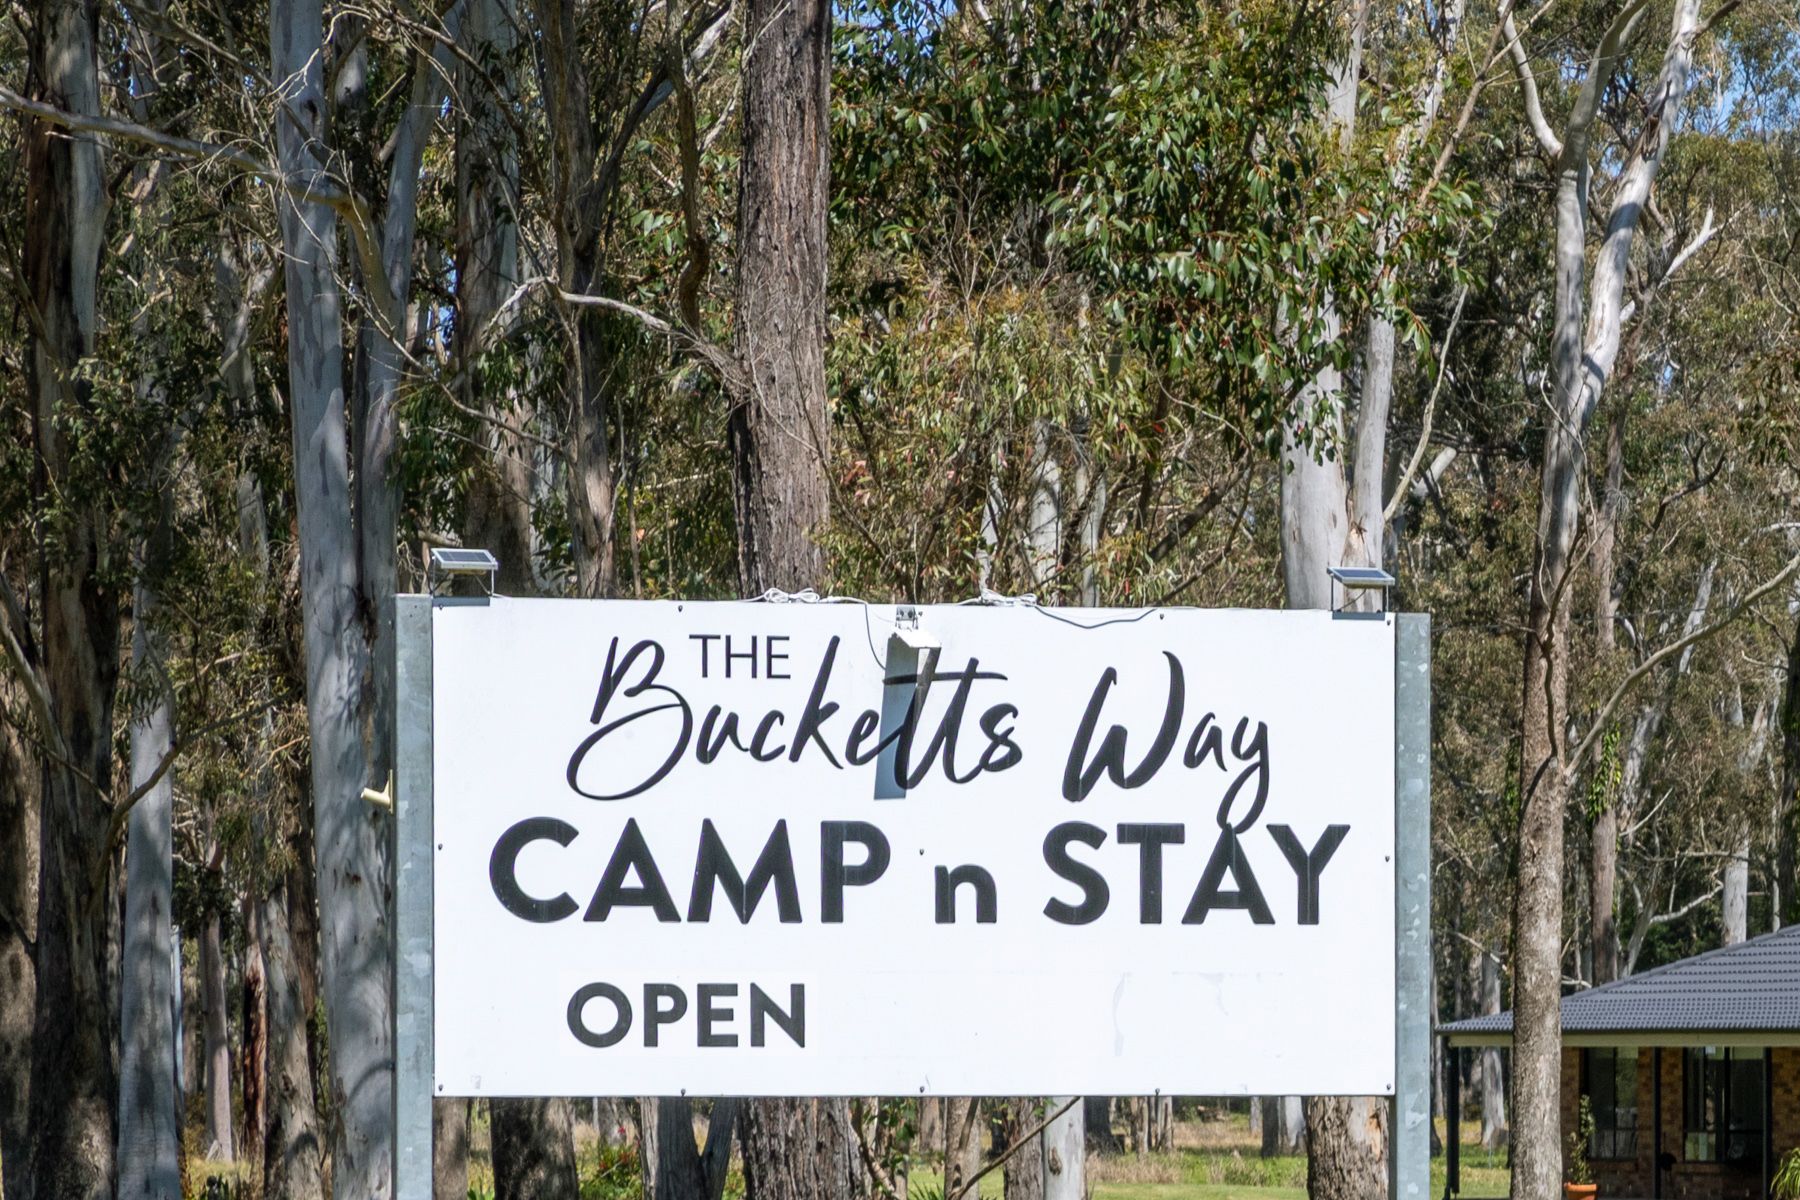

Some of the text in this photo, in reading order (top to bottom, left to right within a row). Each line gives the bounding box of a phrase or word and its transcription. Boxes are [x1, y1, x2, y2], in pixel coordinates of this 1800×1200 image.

[689, 634, 791, 680] THE
[565, 634, 1270, 834] Bucketts Way
[488, 816, 1351, 926] CAMP n STAY
[566, 981, 806, 1048] OPEN
